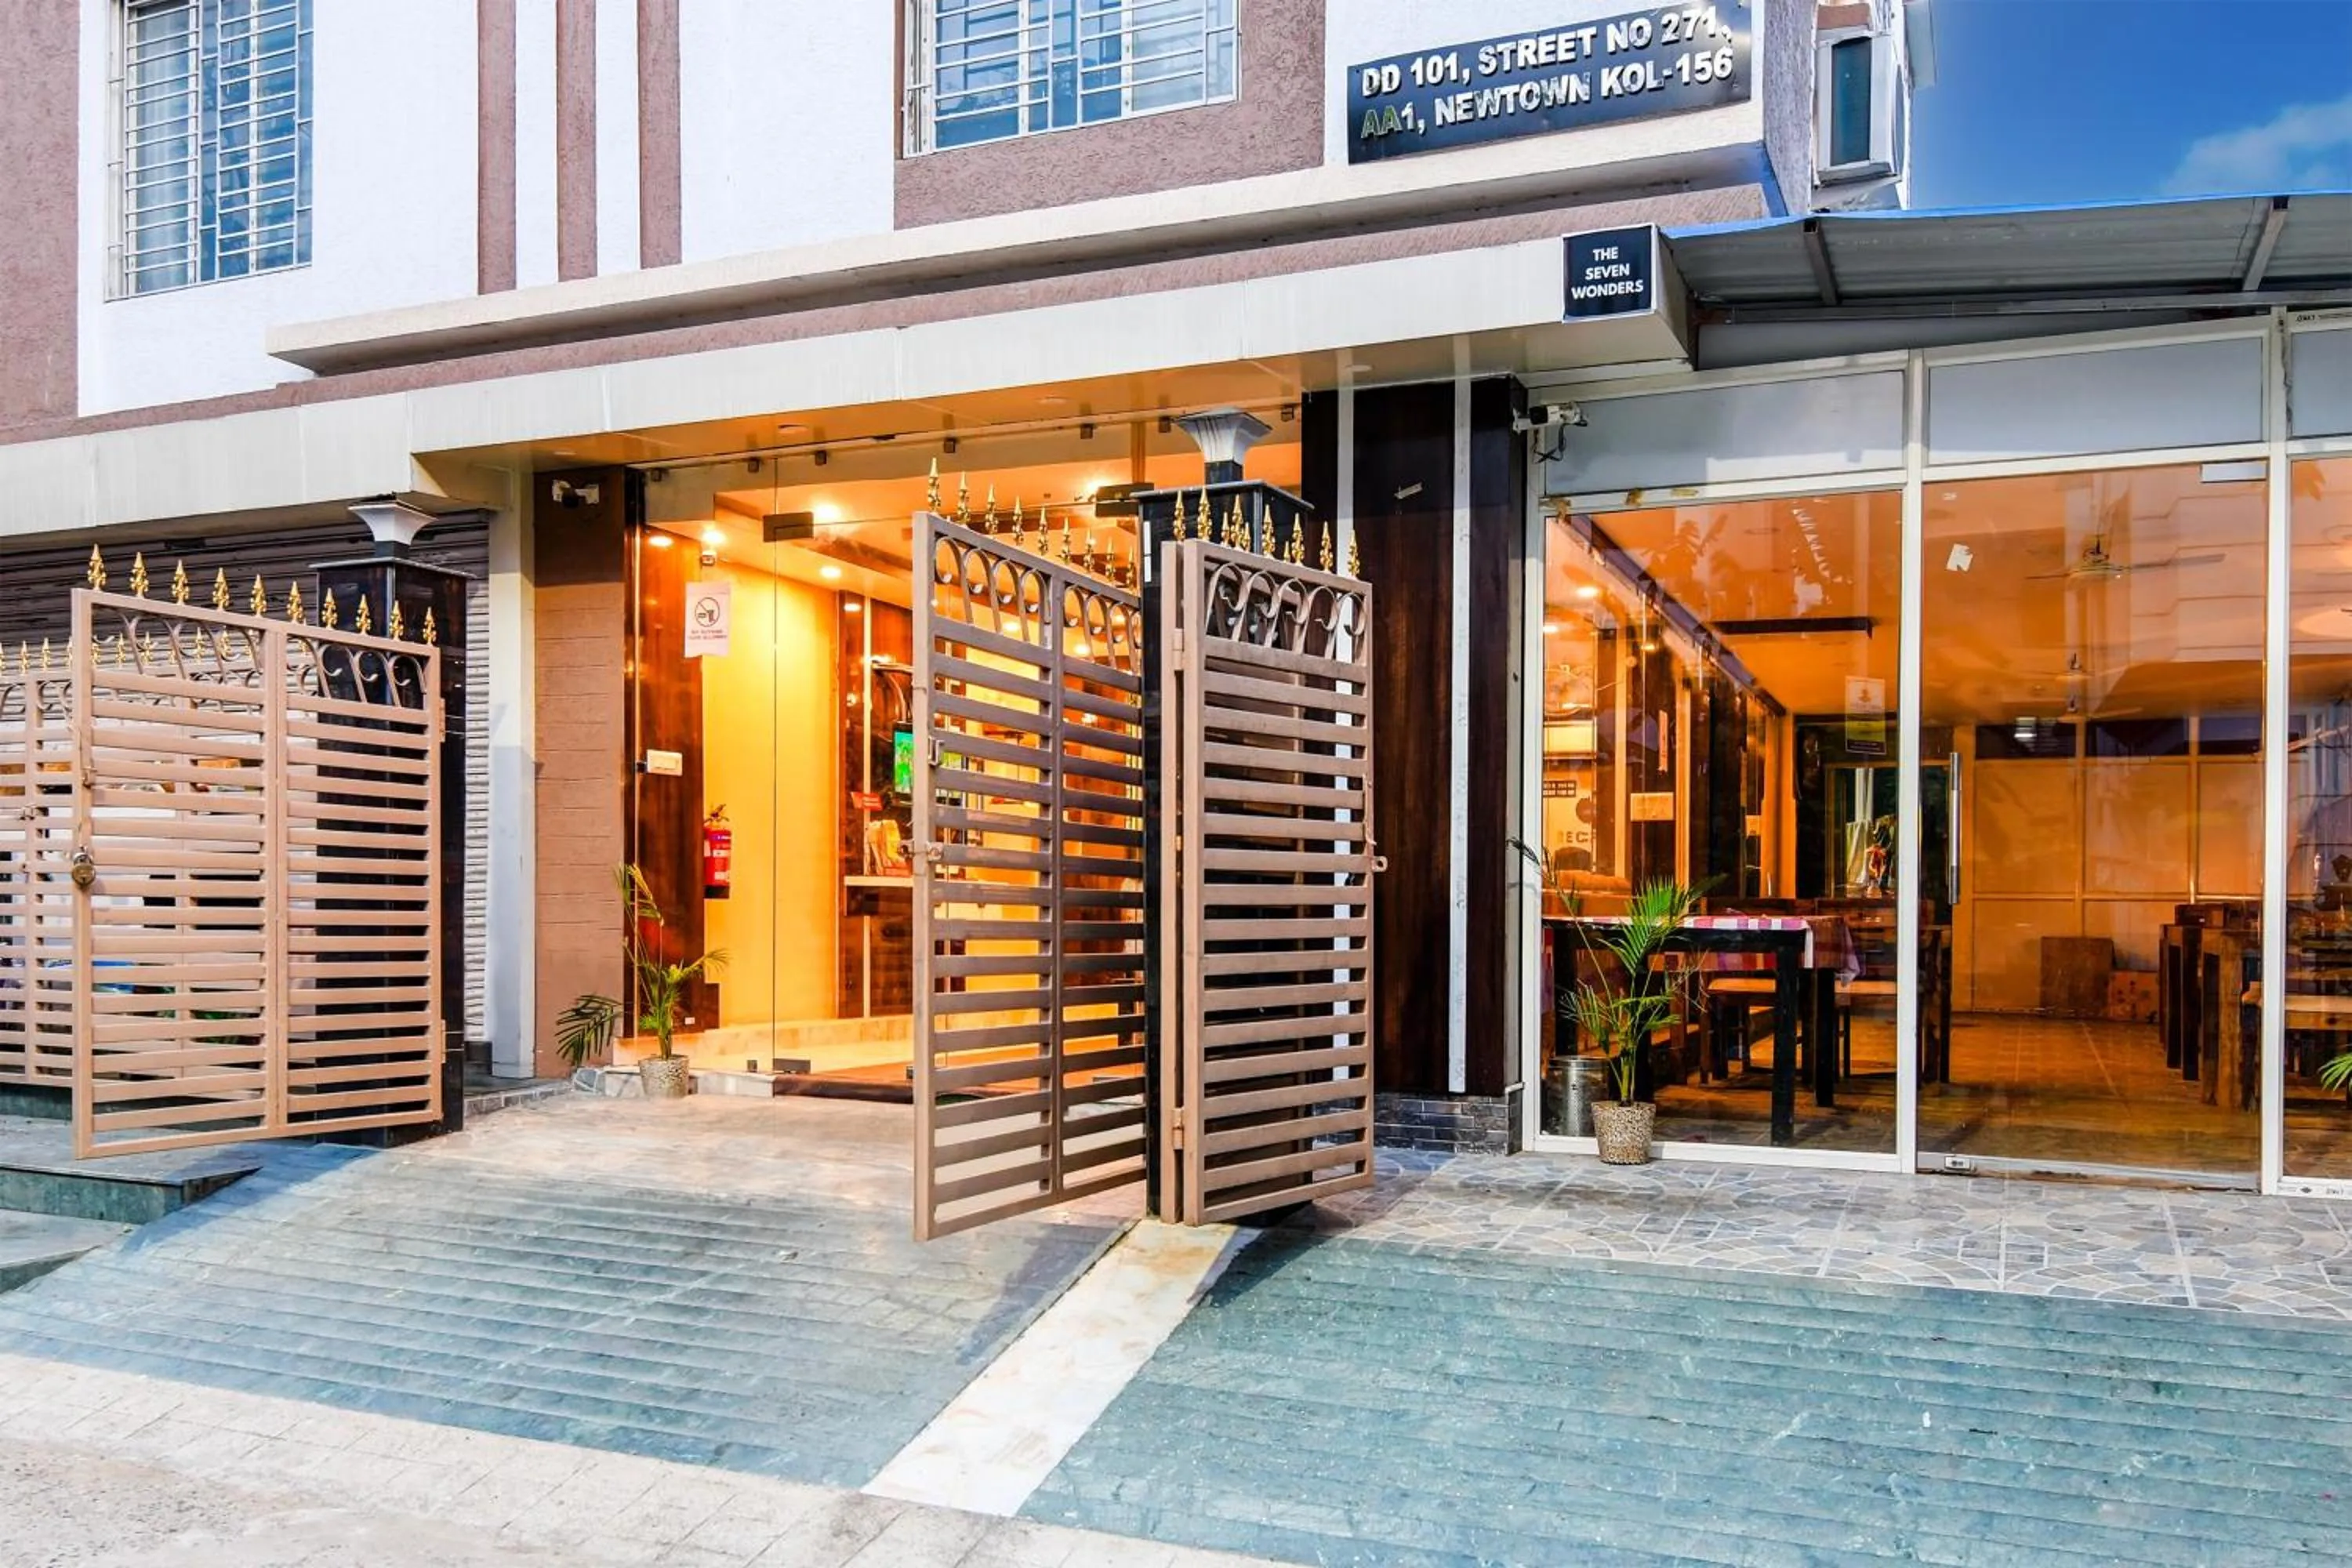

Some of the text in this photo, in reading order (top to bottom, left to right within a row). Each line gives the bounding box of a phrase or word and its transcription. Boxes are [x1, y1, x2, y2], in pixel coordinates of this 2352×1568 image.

[1363, 64, 1401, 97] DD
[1410, 52, 1472, 85] 101,
[1478, 26, 1597, 75] STREET
[1606, 17, 1653, 53] NO
[1434, 71, 1592, 127] NEWTOWN
[1600, 45, 1733, 97] KOL-156
[1592, 246, 1619, 262] THE
[1584, 263, 1630, 281] SEVEN
[1570, 279, 1644, 300] WONDERS
